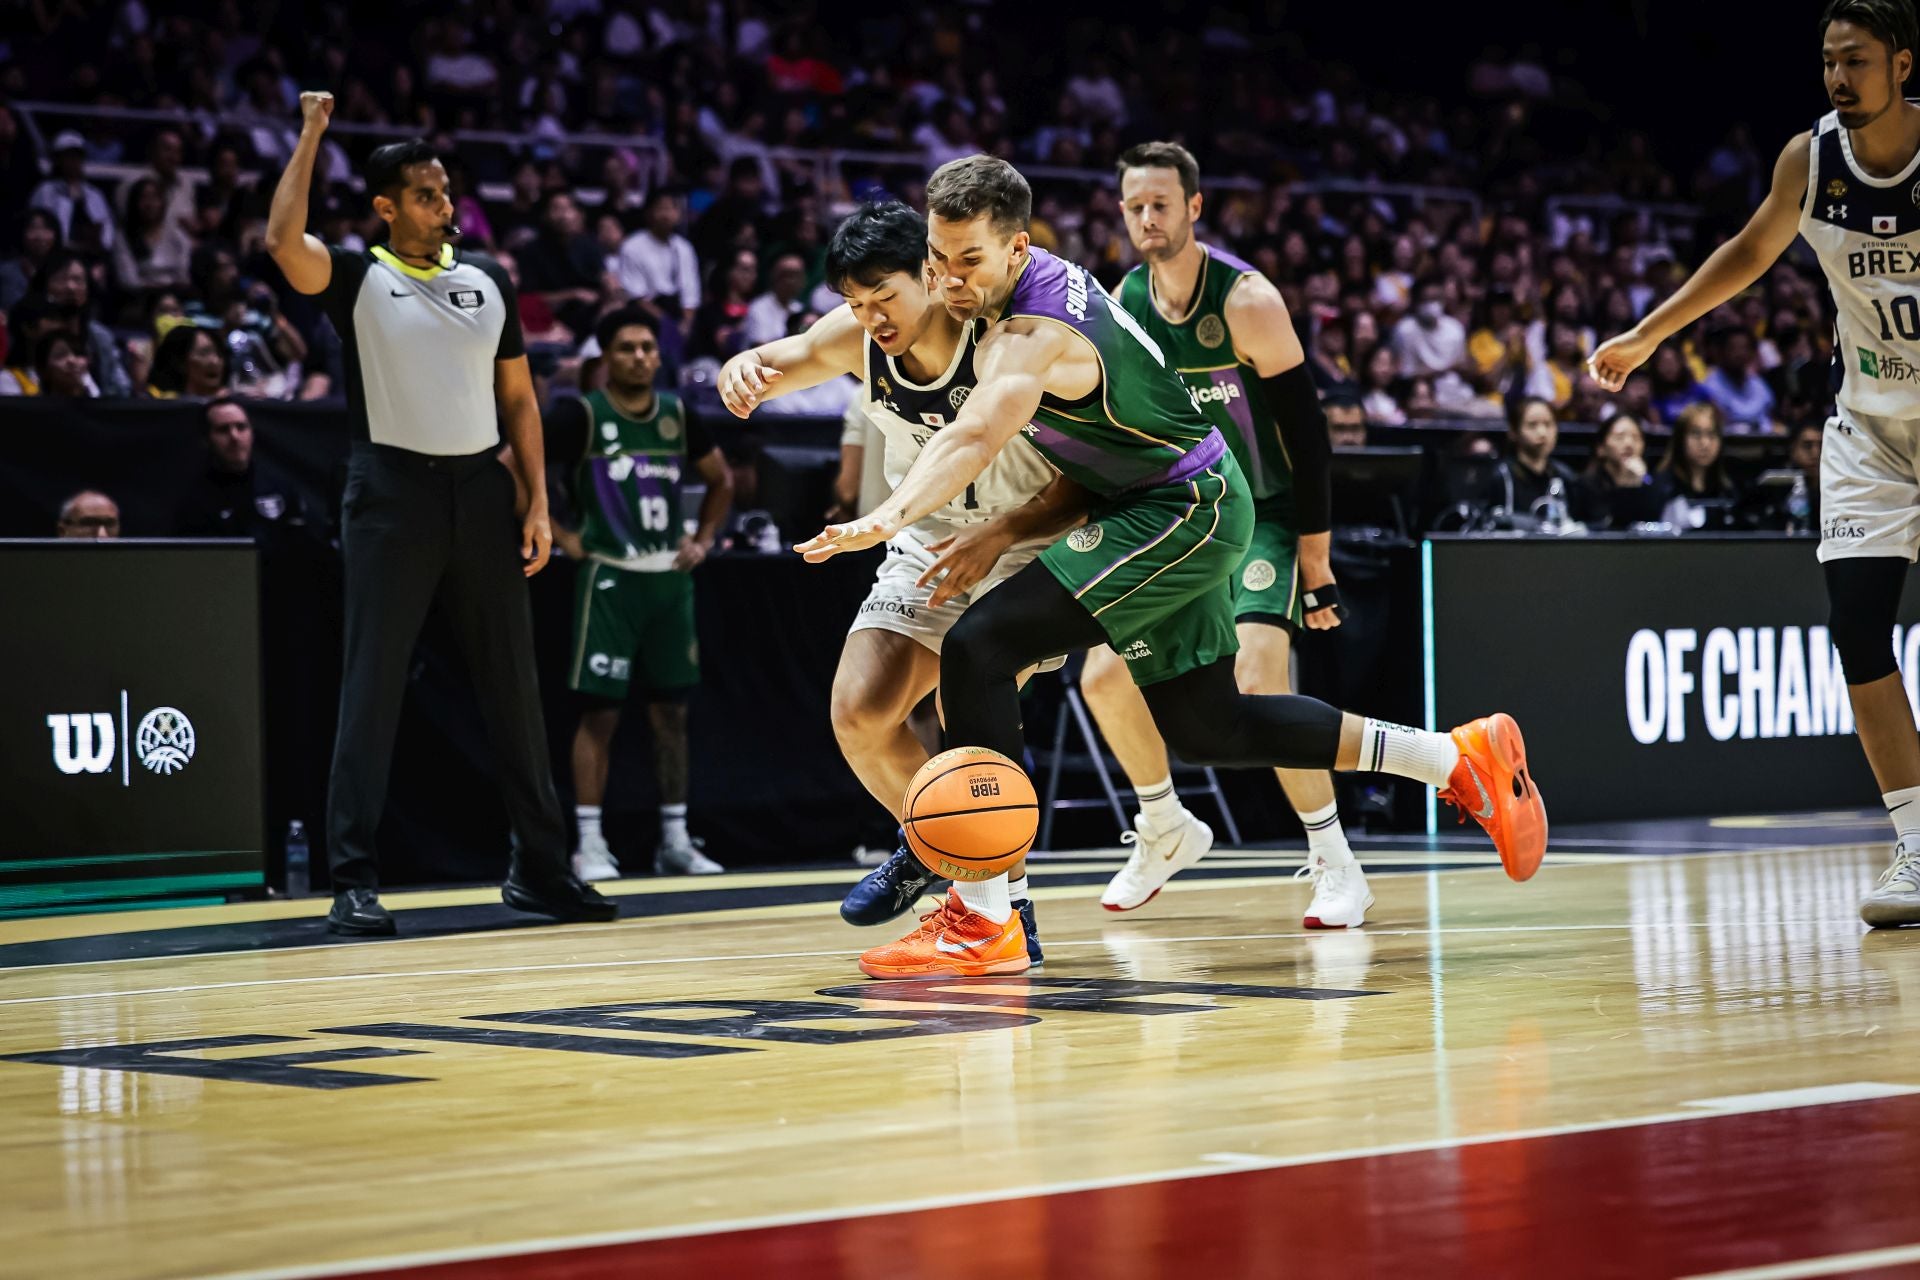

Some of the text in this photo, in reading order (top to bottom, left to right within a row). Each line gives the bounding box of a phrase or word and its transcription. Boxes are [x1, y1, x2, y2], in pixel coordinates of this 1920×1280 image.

[1849, 249, 1920, 279] BREX
[1871, 295, 1920, 342] 10
[638, 496, 669, 532] 13
[1625, 627, 1698, 745] OF
[970, 782, 1001, 798] FIBA
